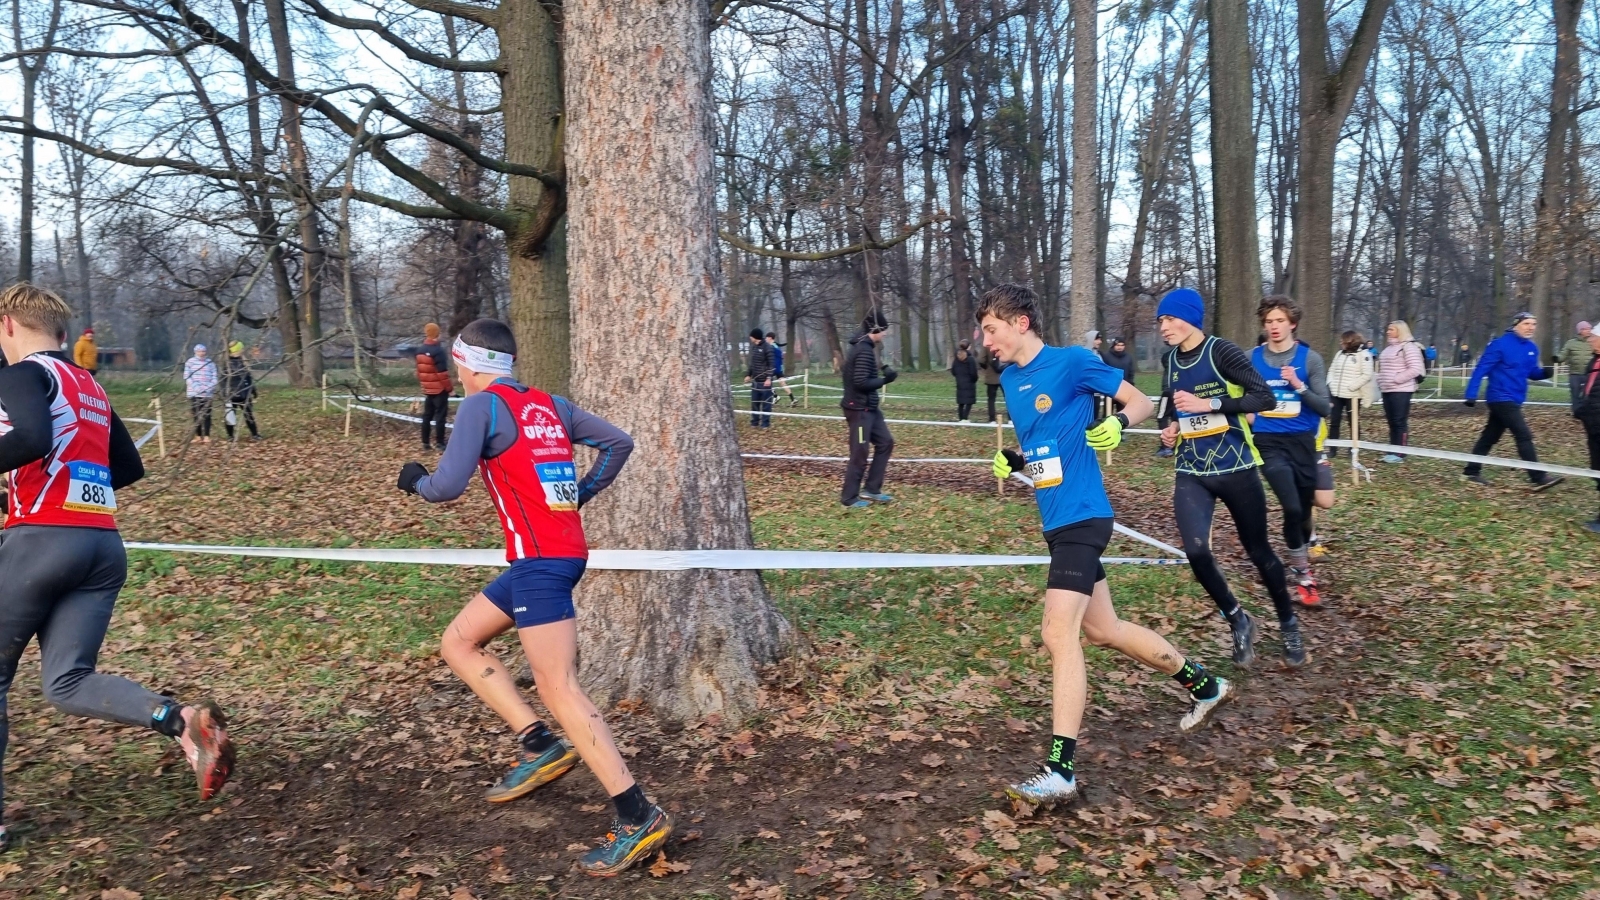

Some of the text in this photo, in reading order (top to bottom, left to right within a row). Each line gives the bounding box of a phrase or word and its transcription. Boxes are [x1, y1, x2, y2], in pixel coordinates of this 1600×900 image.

[1194, 381, 1220, 391] ATLETIKA
[77, 392, 107, 411] ATLETIKA
[79, 407, 109, 427] OLOMOUC
[1189, 415, 1209, 427] 845
[81, 483, 106, 505] 883
